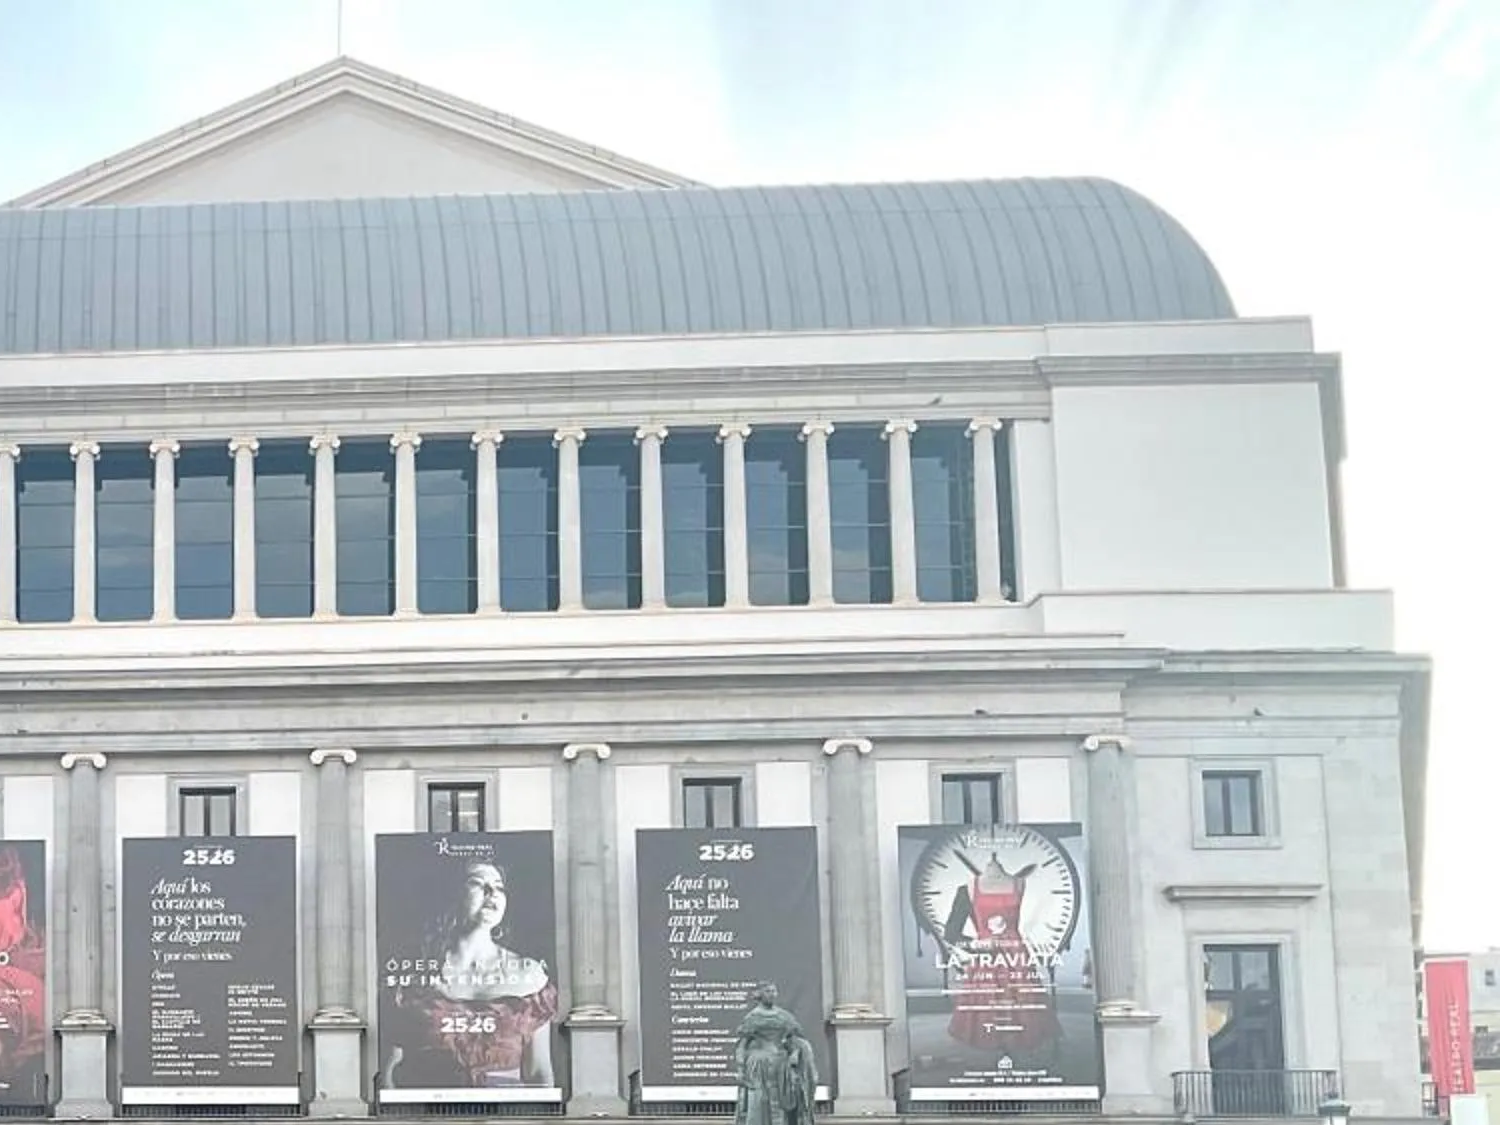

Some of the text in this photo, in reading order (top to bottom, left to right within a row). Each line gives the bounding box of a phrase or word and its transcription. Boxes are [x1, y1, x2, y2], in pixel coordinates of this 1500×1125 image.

[191, 876, 212, 894] los
[708, 878, 729, 891] no
[151, 898, 226, 911] corazones
[707, 892, 740, 909] falta
[152, 915, 173, 927] no
[175, 915, 191, 927] se
[669, 926, 733, 943] la llama
[385, 957, 452, 972] ÓPERA
[935, 952, 1065, 969] LA TRAVIATA
[386, 975, 412, 987] SU
